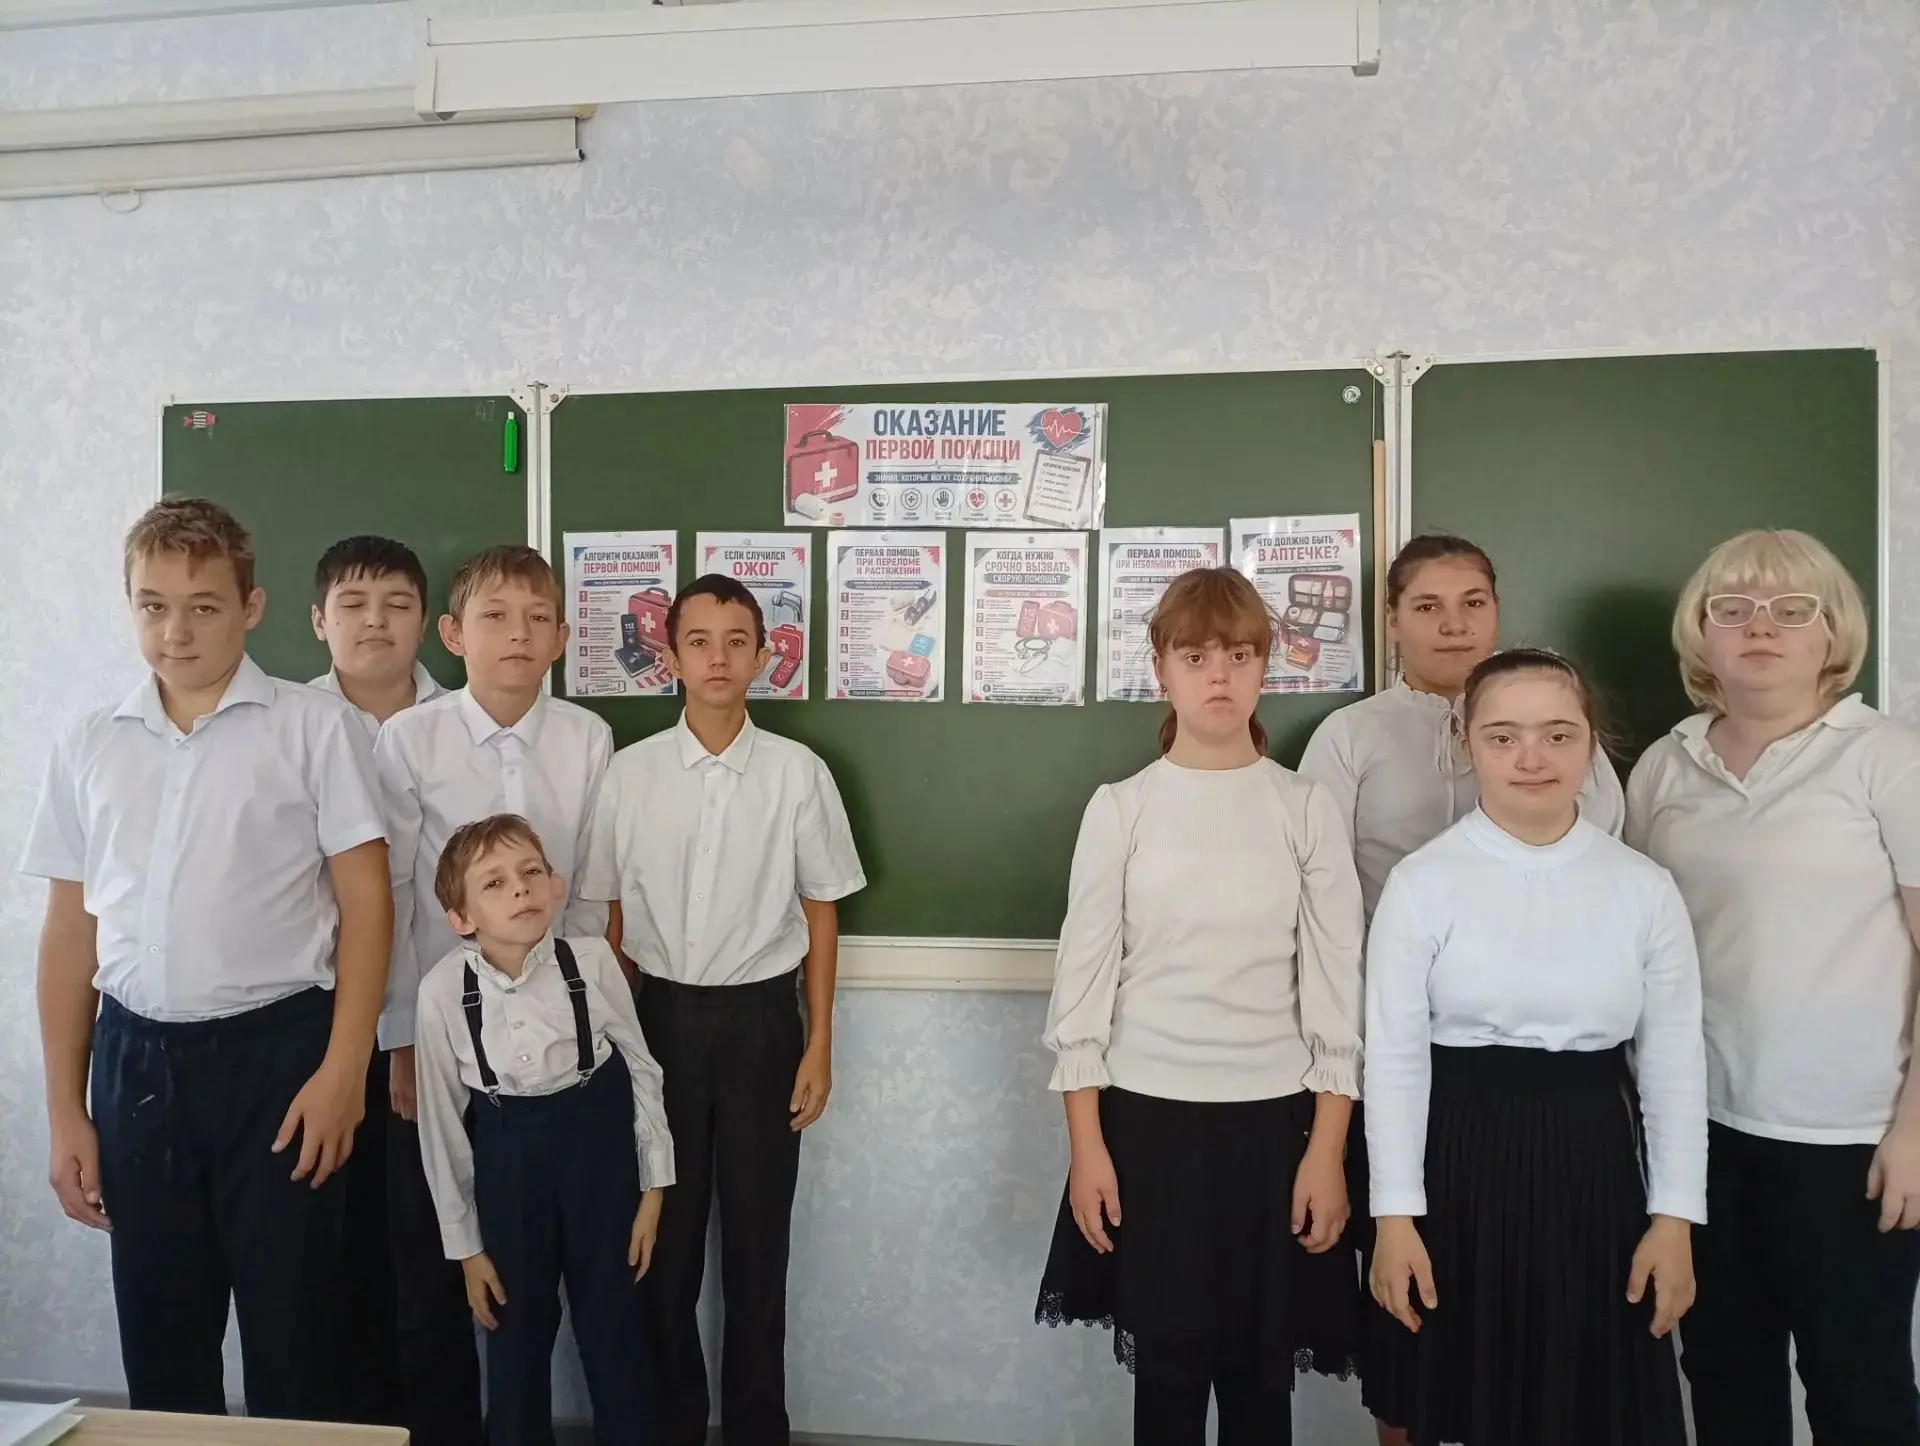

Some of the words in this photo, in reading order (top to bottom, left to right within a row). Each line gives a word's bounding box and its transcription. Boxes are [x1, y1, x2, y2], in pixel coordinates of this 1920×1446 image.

[873, 408, 1007, 436] ОКАЗАНИЕ
[865, 436, 935, 460] ПЕРВОЙ
[941, 438, 1021, 463] ПОМОЩИ
[930, 473, 951, 482] МОГУТ
[1256, 537, 1273, 547] ЧТО
[1274, 536, 1310, 547] ДОЛЖНО
[1311, 535, 1334, 545] БЫТЬ
[584, 551, 621, 561] АЛГОРИТМ
[622, 550, 659, 560] ОКАЗАНИЯ
[724, 551, 744, 560] ЕСЛИ
[745, 550, 786, 561] СЛУЧИЛСЯ
[855, 548, 885, 557] ПЕРВАЯ
[886, 548, 920, 558] ПОМОЩЬ
[996, 550, 1023, 561] КОГДА
[1025, 551, 1054, 560] НУЖНО
[1127, 548, 1160, 559] ПЕРВАЯ
[1163, 548, 1202, 559] ПОМОЩЬ
[1257, 548, 1266, 561] В
[1270, 545, 1340, 561] АПТЕЧКЕ?
[856, 557, 874, 566] ПРИ
[876, 557, 921, 566] ПЕРЕЛОМЕ
[985, 561, 1022, 572] СРОЧНО
[1025, 561, 1070, 572] ВЫЗВАТЬ
[1116, 560, 1131, 569] ПРИ
[1132, 560, 1177, 569] НЕБОЛЬШИХ
[1178, 560, 1211, 569] ТРАВМАХ
[584, 561, 619, 574] ПЕРВОЙ
[621, 561, 661, 574] ПОМОЩИ
[733, 561, 779, 576] ОЖОГ
[856, 567, 862, 575] И
[864, 566, 921, 575] РАСТЯЖЕНИИ
[993, 574, 1023, 584] СКОРУЮ
[1024, 574, 1061, 584] ПОМОЩЬ?
[782, 660, 794, 669] 112
